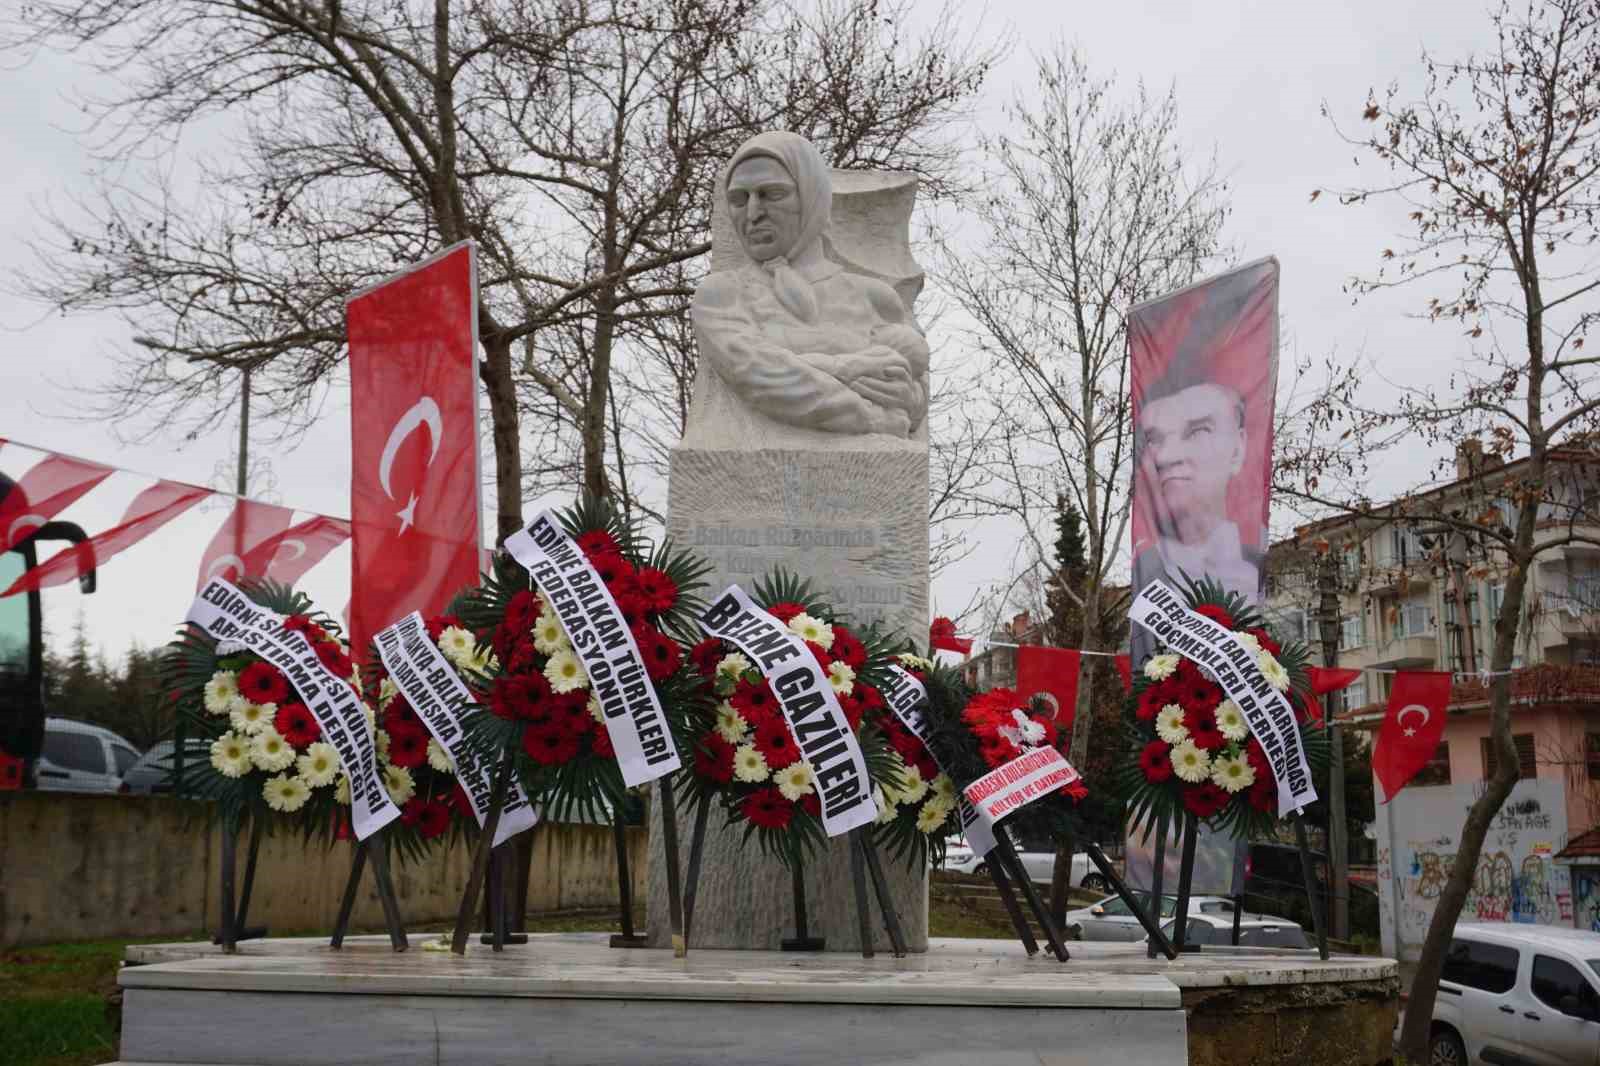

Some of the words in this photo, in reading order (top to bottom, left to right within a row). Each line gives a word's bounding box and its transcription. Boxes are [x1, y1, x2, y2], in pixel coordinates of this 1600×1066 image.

[202, 582, 267, 626] EDİRNE
[303, 653, 351, 704] ÖTESİ
[339, 702, 390, 815] KÜLTÜRLERİ
[527, 515, 583, 572] EDİRNE
[568, 565, 629, 650] BALKAN
[612, 649, 675, 767] TÜRKLERİ
[530, 559, 627, 720] FEDERASYONU
[1142, 584, 1228, 645] LÜLEBURGAZ
[1218, 639, 1272, 699] BALKAN
[1264, 695, 1308, 798] YARIMADASI
[1143, 610, 1246, 696] GÖÇMENLERİ
[774, 666, 869, 820] GAZİLERİ
